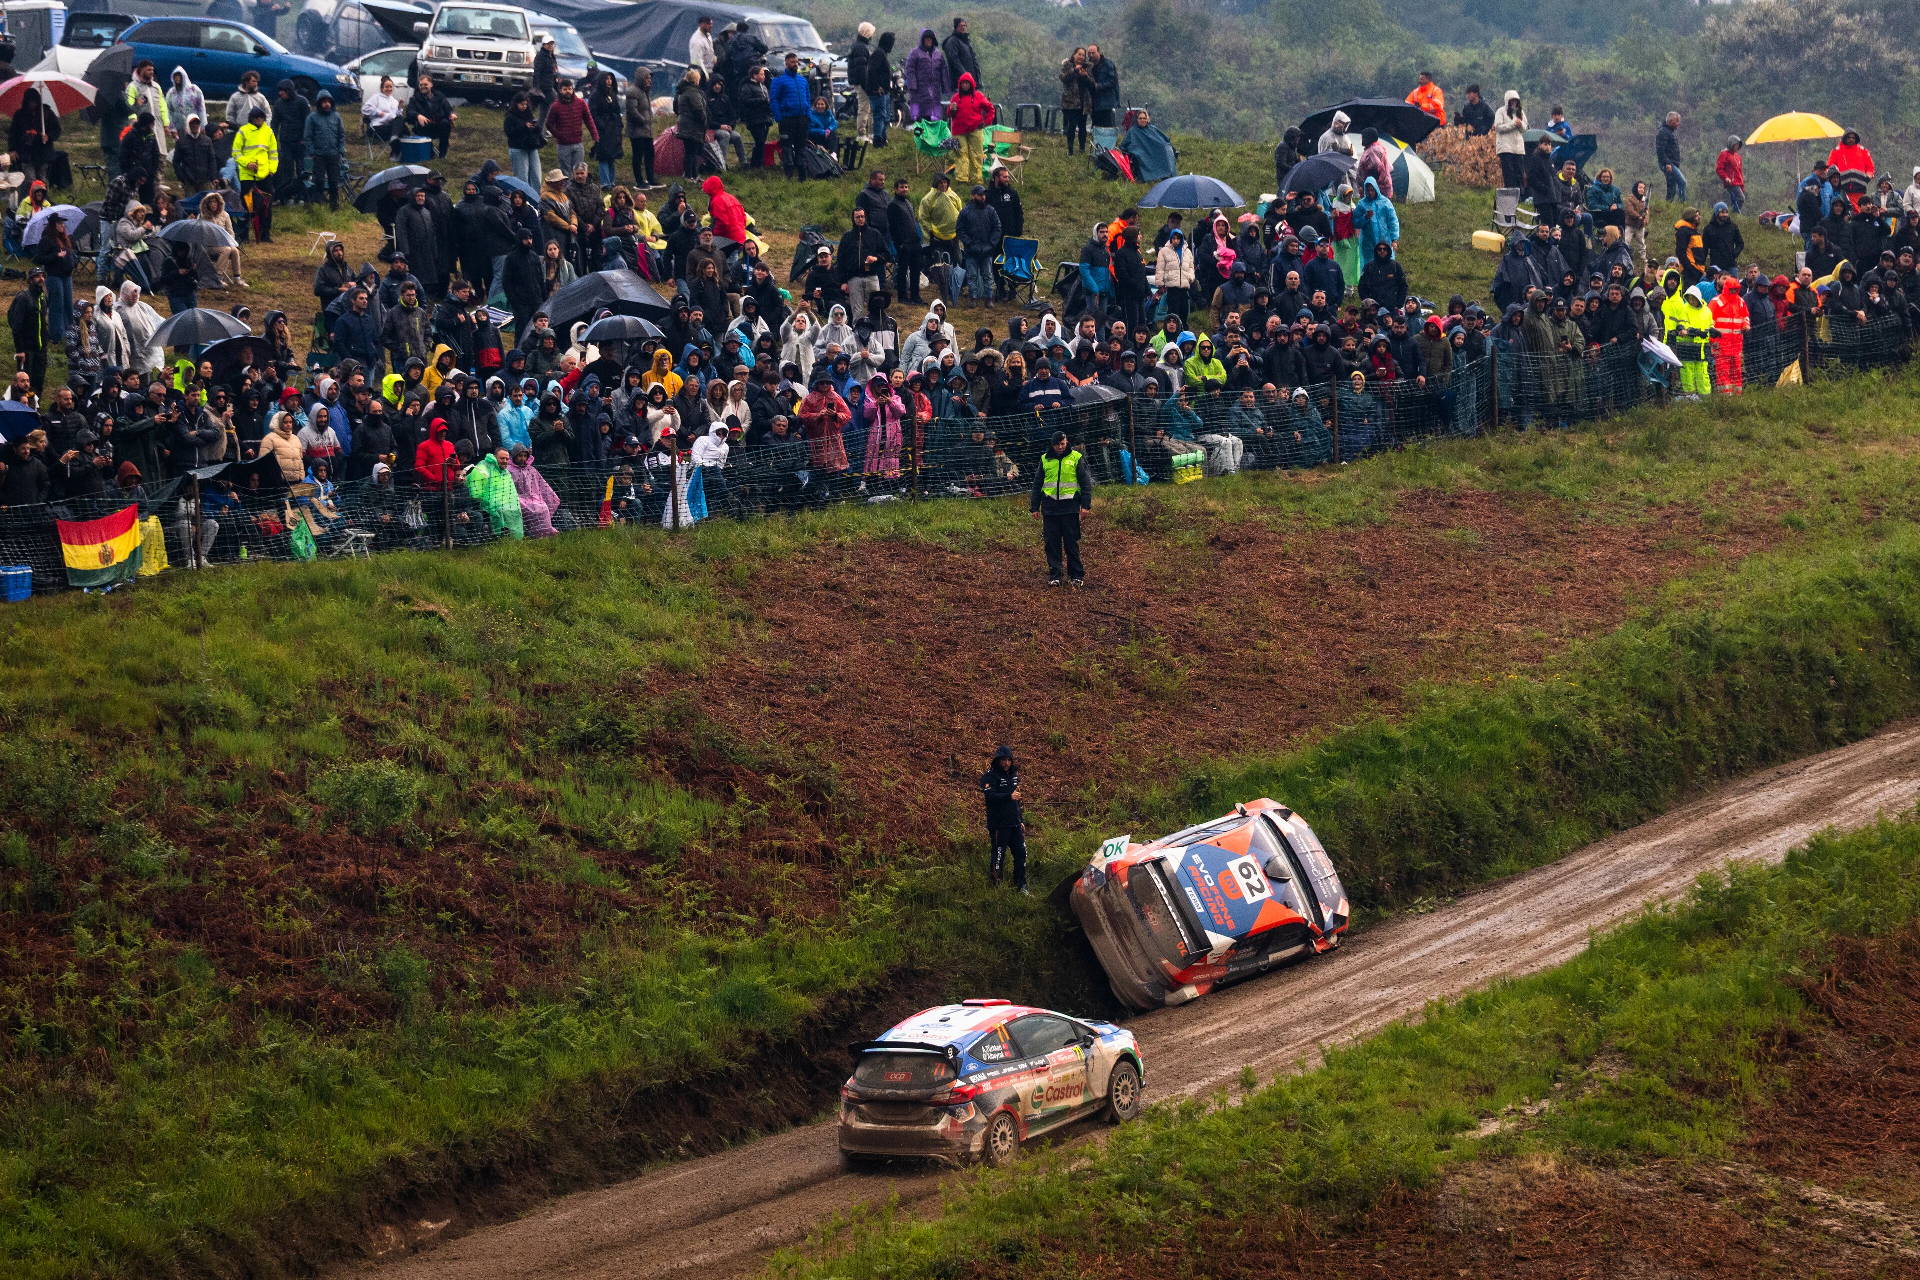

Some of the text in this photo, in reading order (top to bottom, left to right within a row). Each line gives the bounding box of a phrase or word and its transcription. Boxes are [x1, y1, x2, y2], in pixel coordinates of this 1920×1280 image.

[1103, 840, 1126, 858] OK
[1187, 865, 1225, 926] RACING
[1191, 853, 1236, 931] EVOFONE
[1238, 861, 1266, 898] 62
[1045, 1081, 1084, 1102] Castrol
